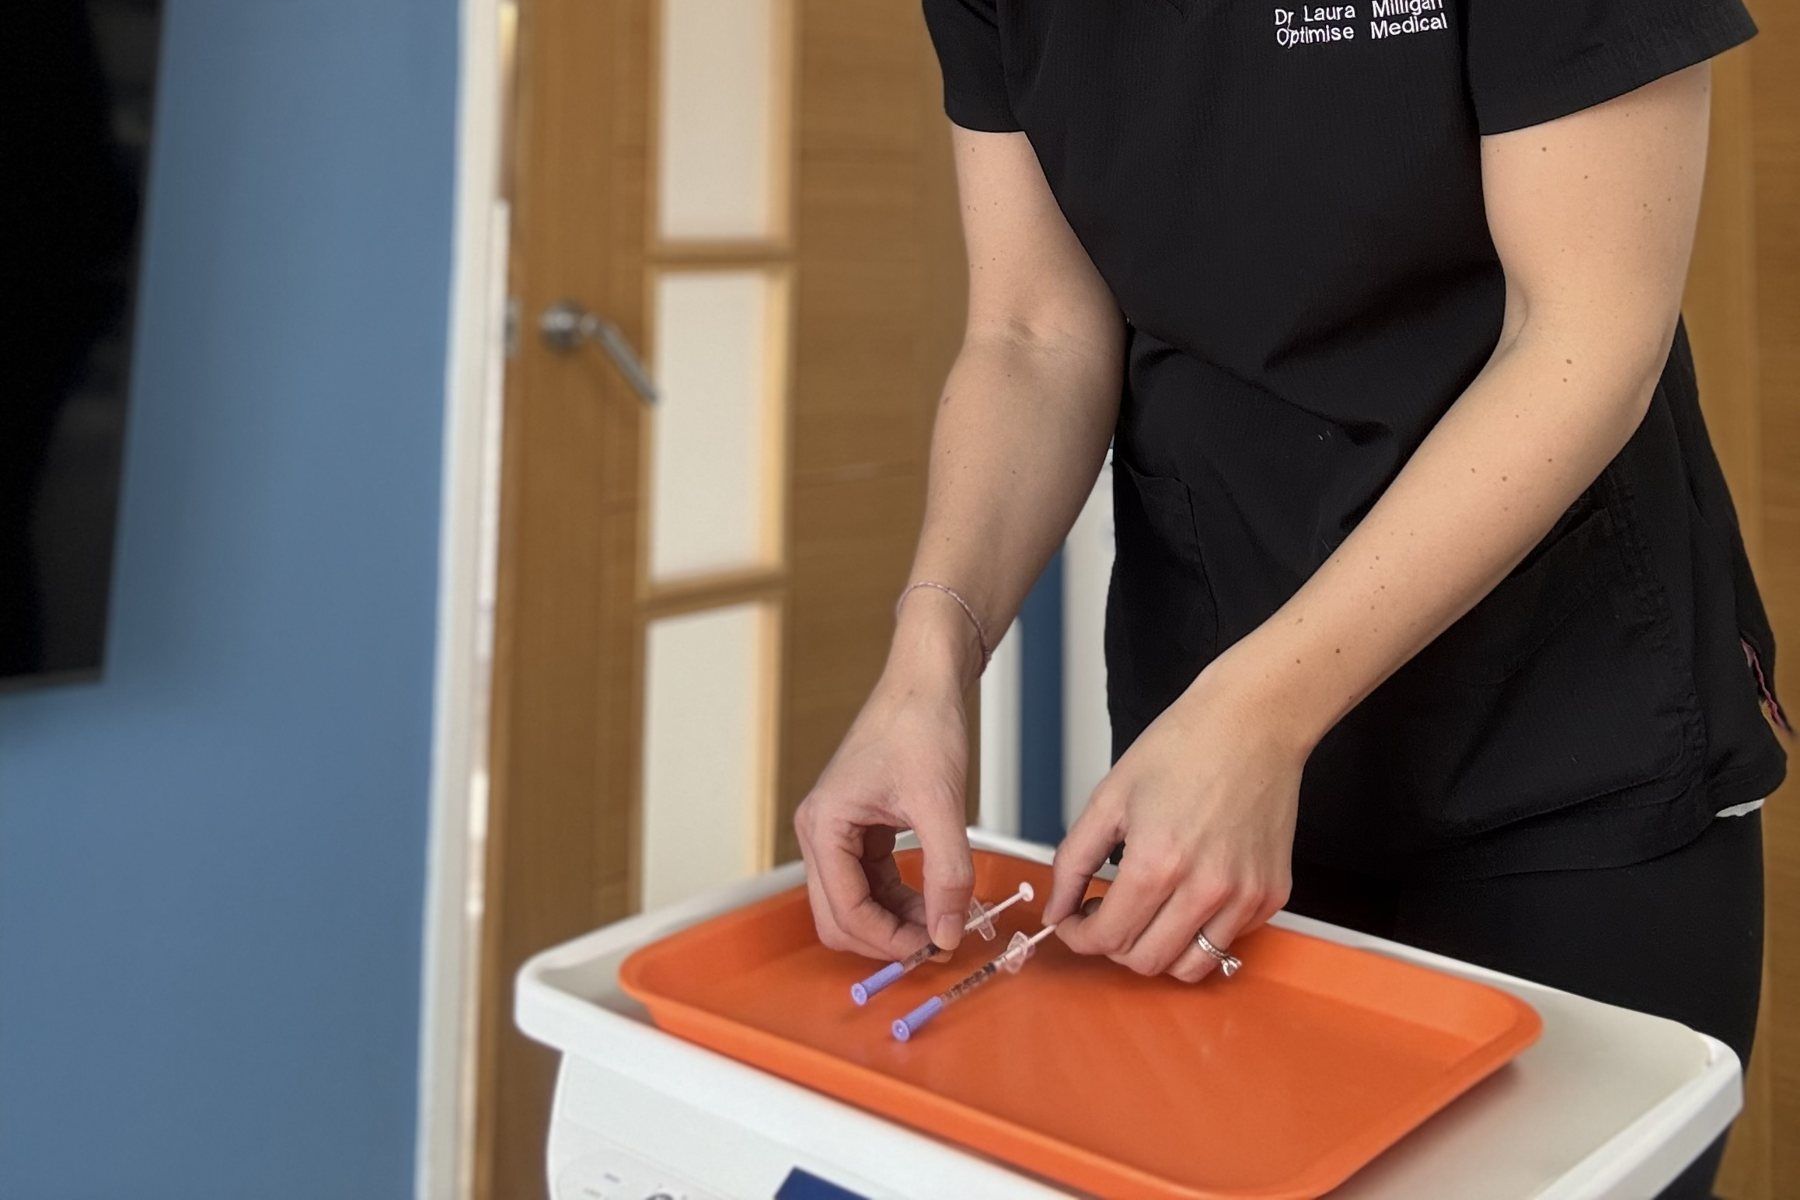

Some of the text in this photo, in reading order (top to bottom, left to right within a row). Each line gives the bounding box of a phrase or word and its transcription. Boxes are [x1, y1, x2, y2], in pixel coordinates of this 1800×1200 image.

[1275, 8, 1294, 26] Dr
[1304, 5, 1356, 22] Laura
[1276, 12, 1448, 49] Optimise Medical
